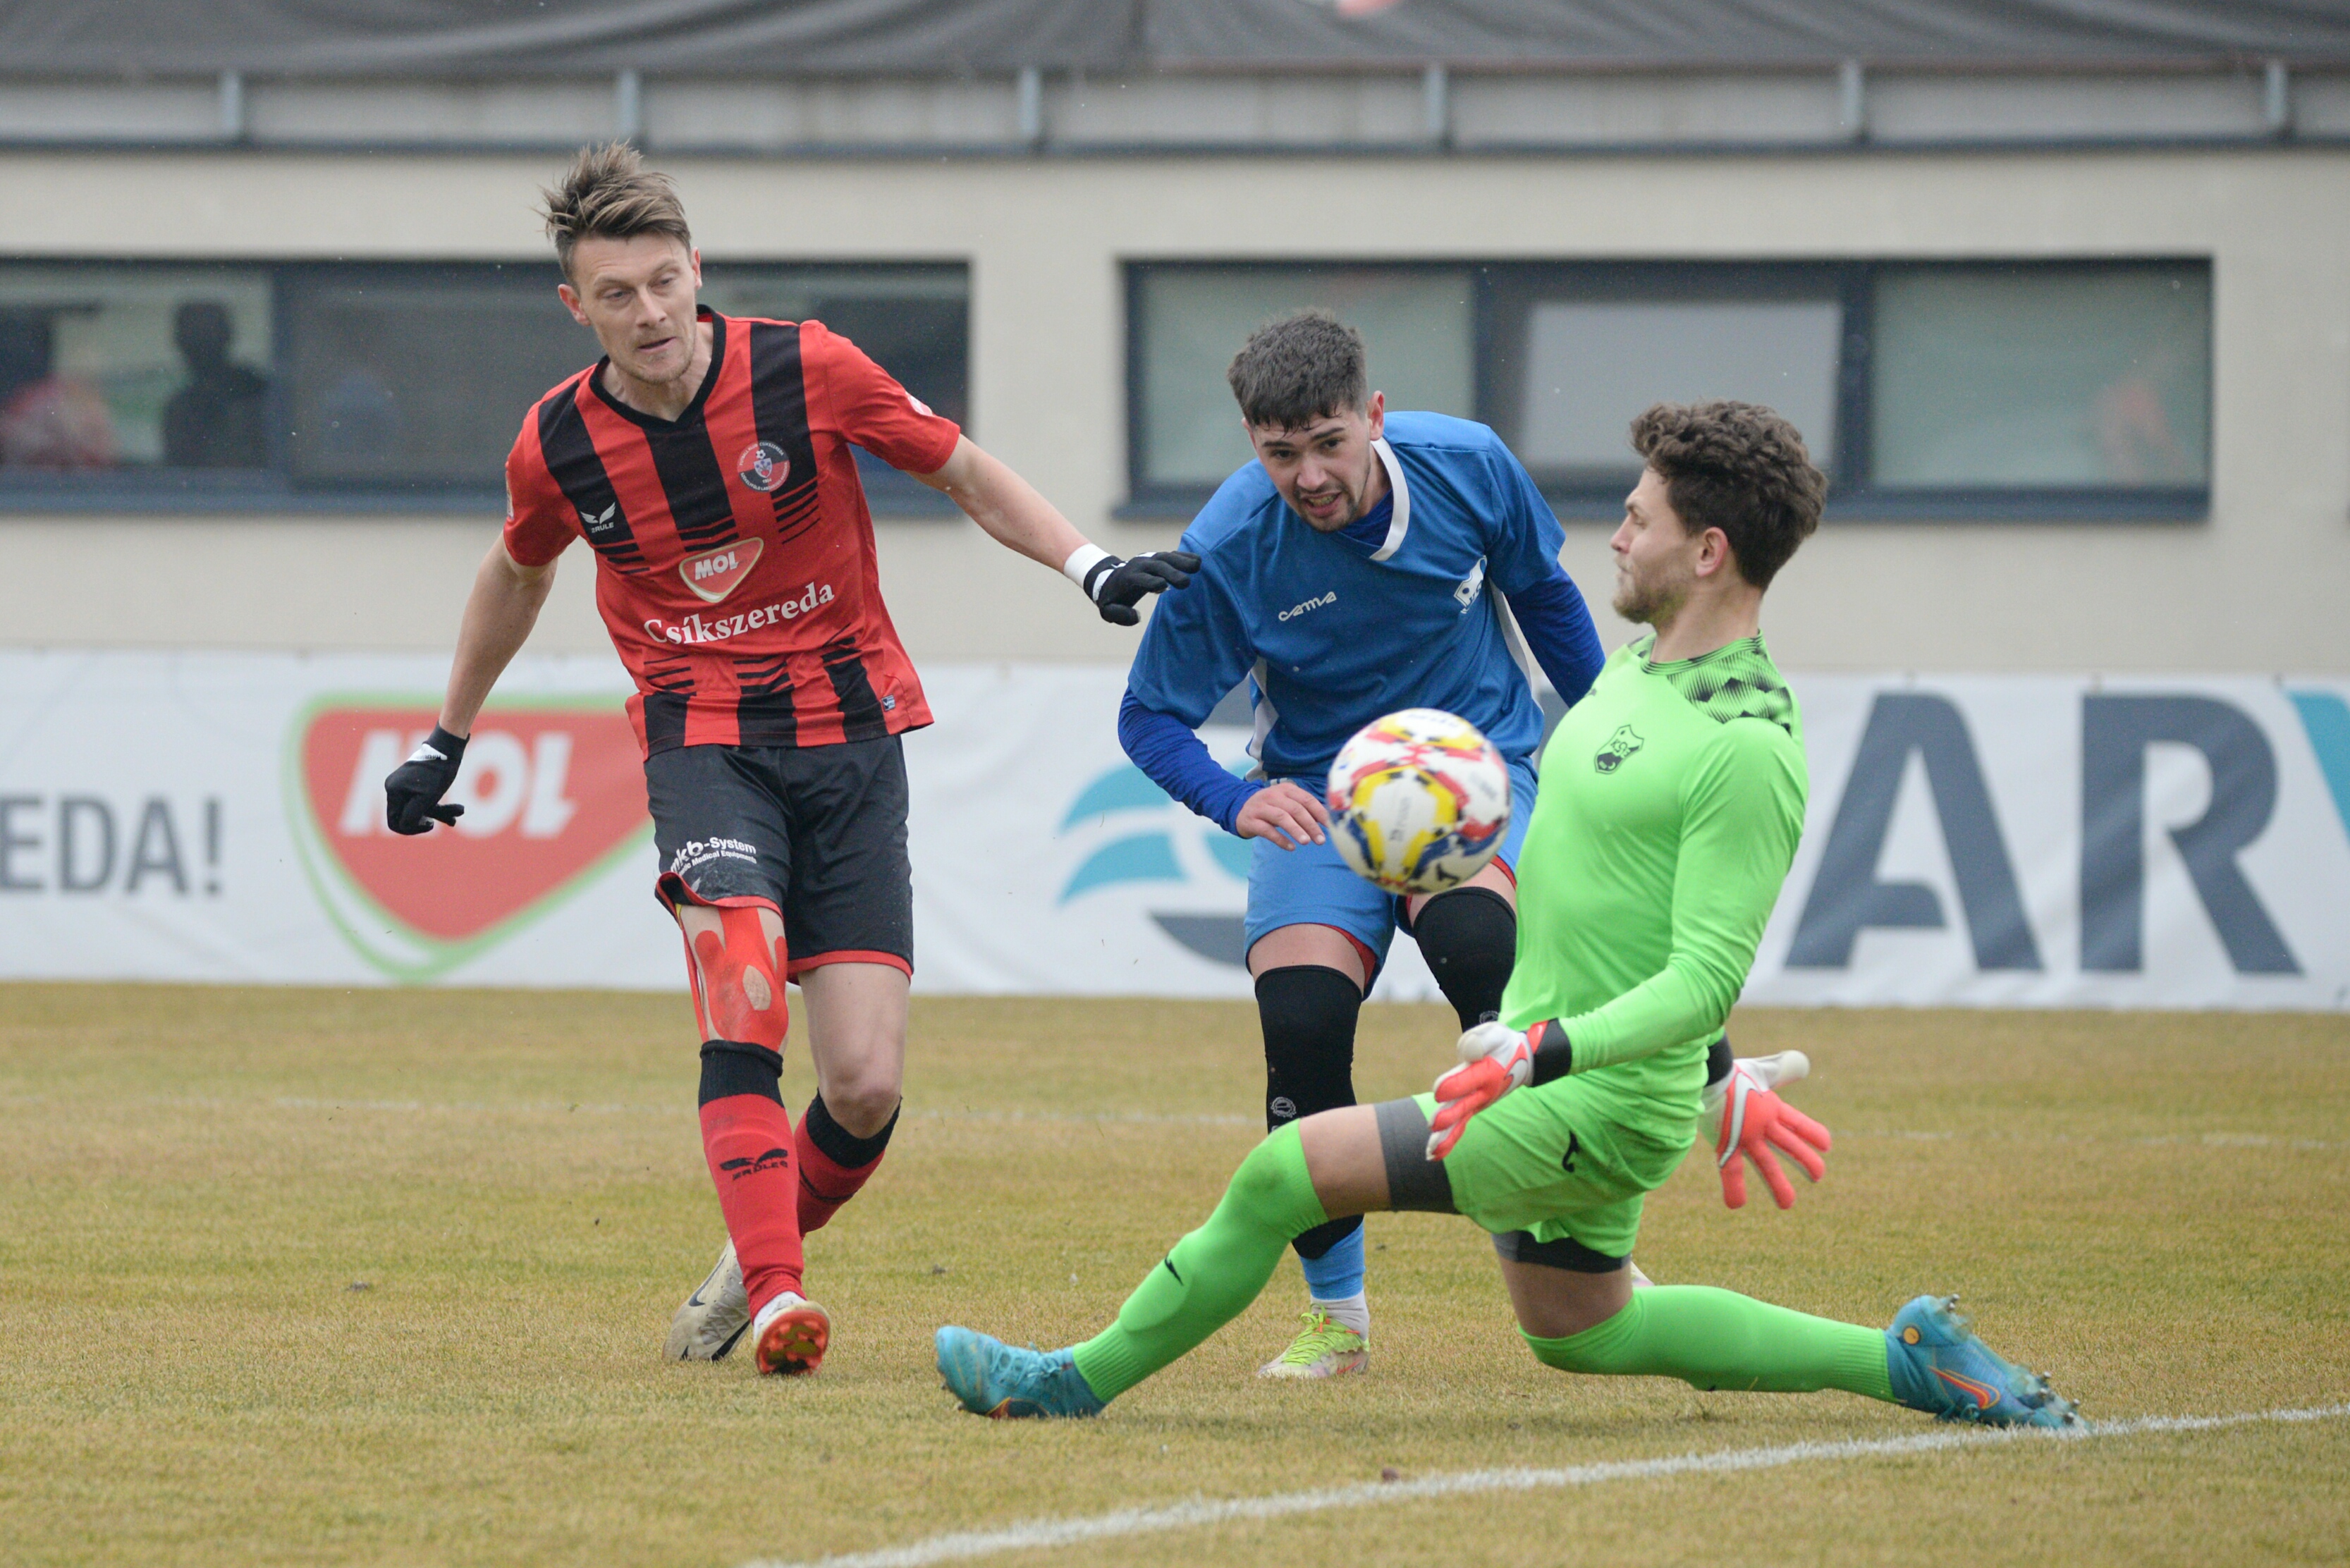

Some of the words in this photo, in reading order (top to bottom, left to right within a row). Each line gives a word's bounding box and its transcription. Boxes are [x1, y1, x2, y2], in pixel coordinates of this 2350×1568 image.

[694, 551, 740, 581] MOL
[644, 581, 836, 645] Csíkszereda
[0, 795, 223, 895] EDA!
[691, 850, 720, 867] Medical
[1782, 690, 2350, 979] AR
